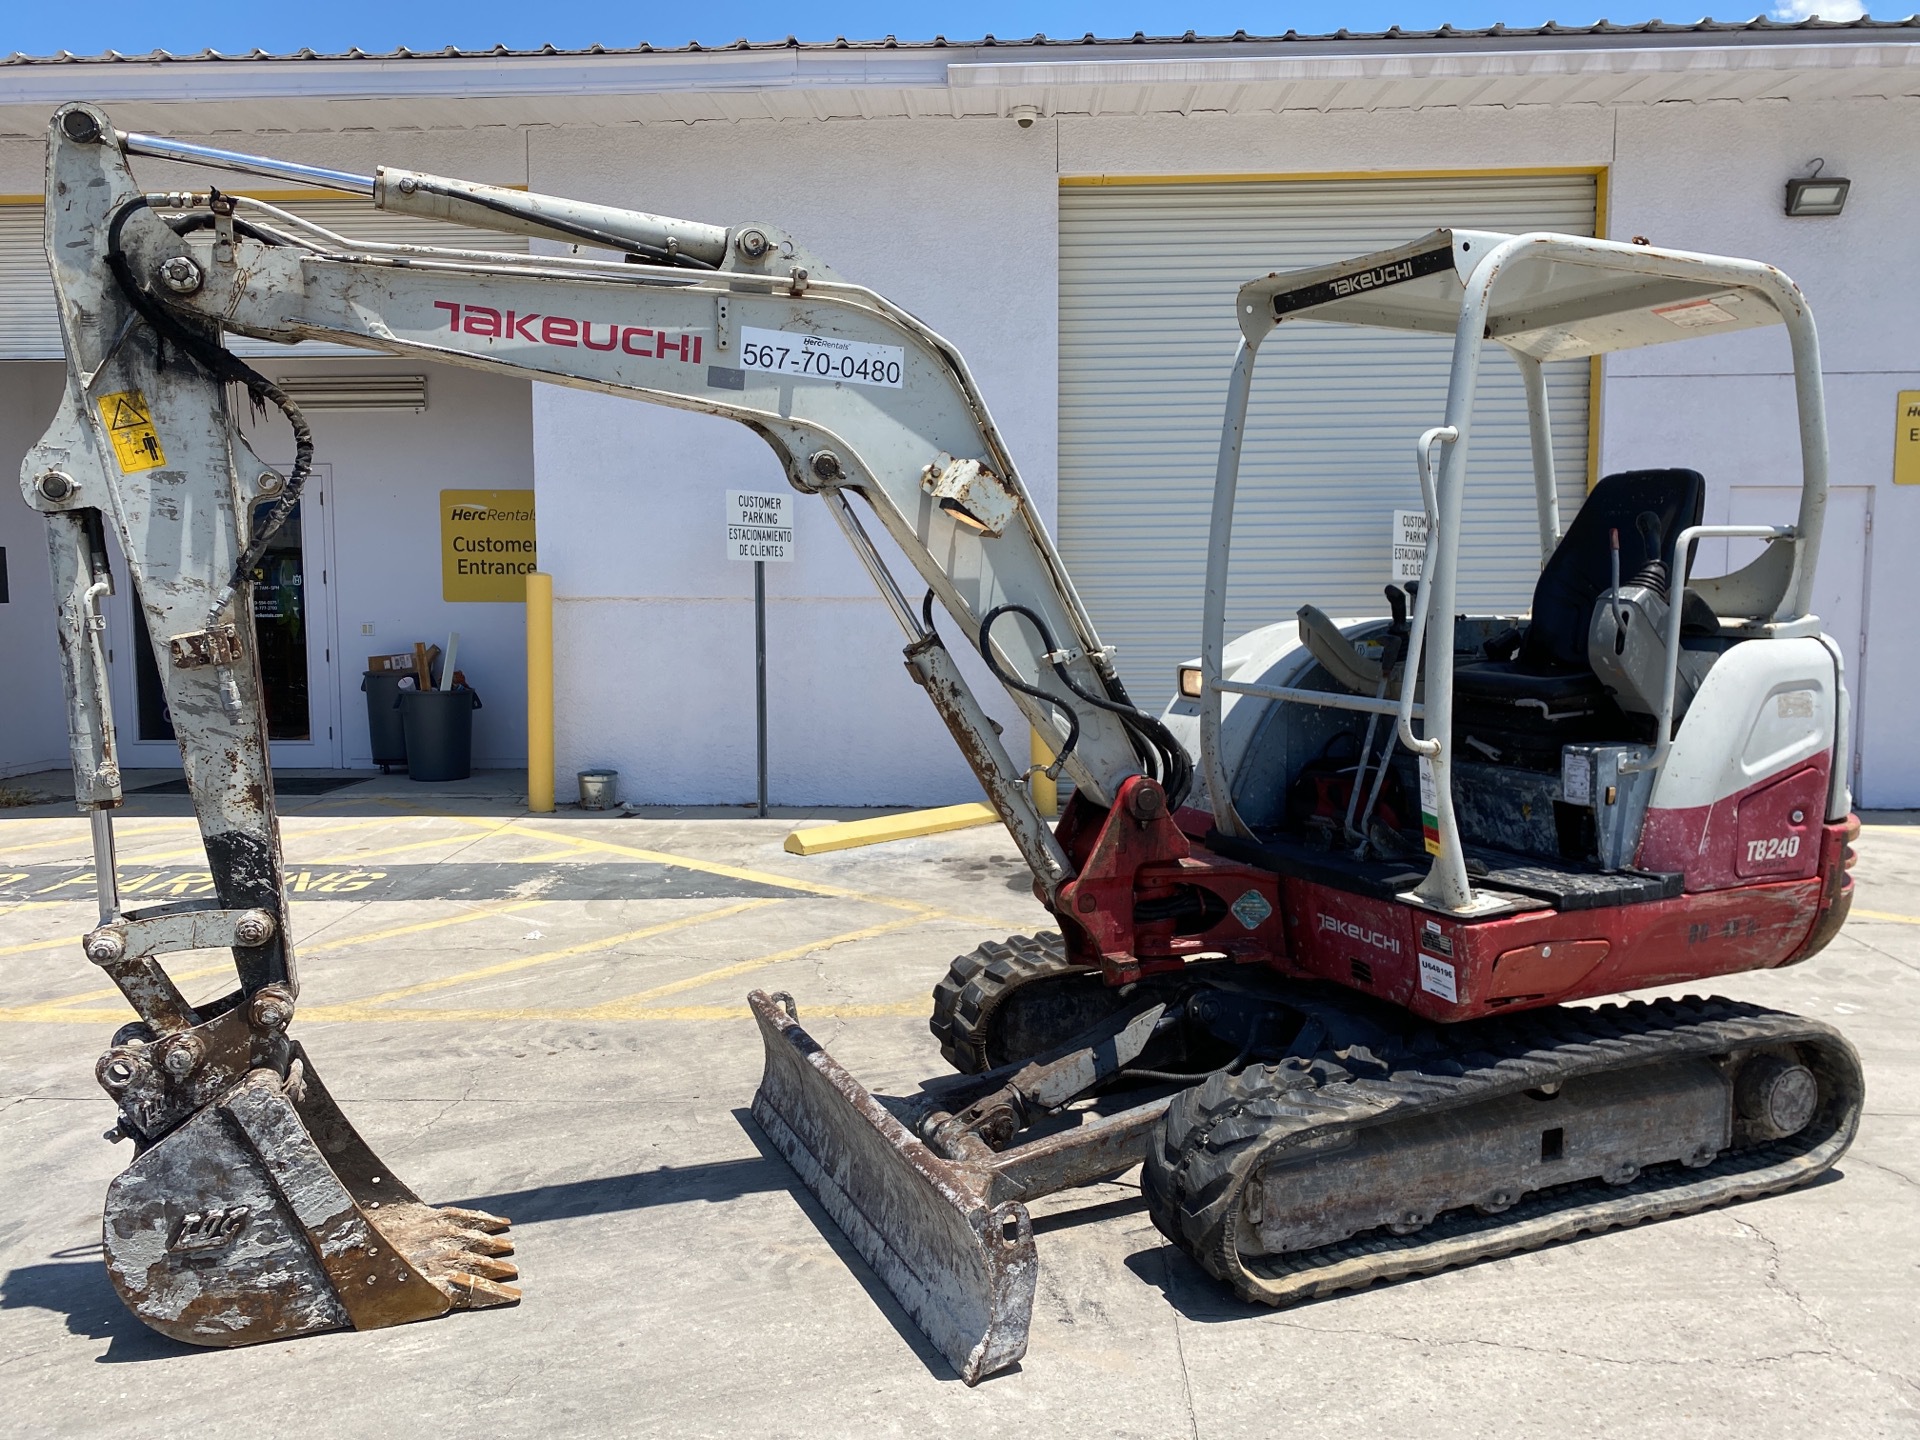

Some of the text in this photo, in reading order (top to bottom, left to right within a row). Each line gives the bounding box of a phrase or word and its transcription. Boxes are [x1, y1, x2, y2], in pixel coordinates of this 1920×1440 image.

[803, 337, 850, 351] HercRentals
[743, 343, 900, 384] 567-70-0480
[738, 494, 782, 510] CUSTOMER
[742, 510, 778, 525] PARKING
[728, 528, 792, 543] ESTACIONAMIENTO
[739, 544, 784, 557] DE CLIENTES
[457, 558, 537, 575] Entrance
[1747, 836, 1800, 862] TB240
